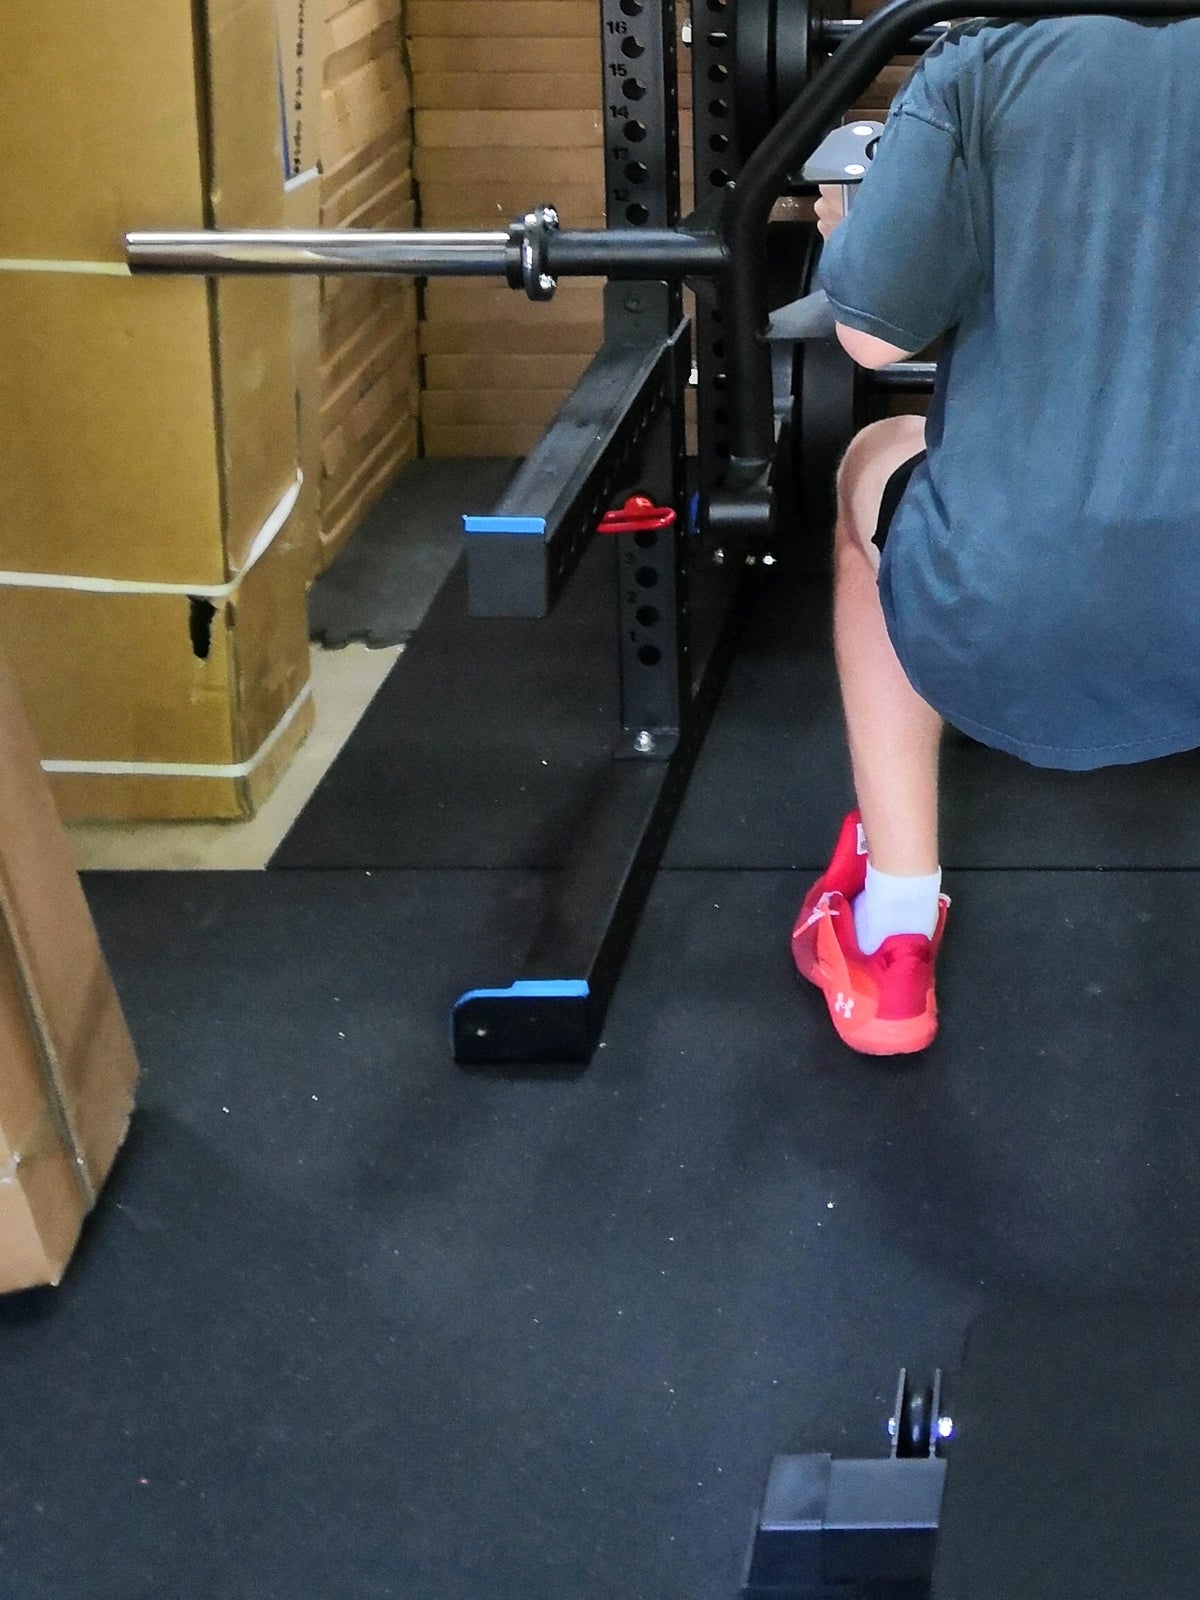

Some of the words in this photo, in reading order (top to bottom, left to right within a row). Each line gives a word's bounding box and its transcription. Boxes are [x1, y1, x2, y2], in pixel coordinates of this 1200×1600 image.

[606, 21, 627, 35] 16
[608, 63, 628, 77] 15
[609, 105, 629, 119] 14
